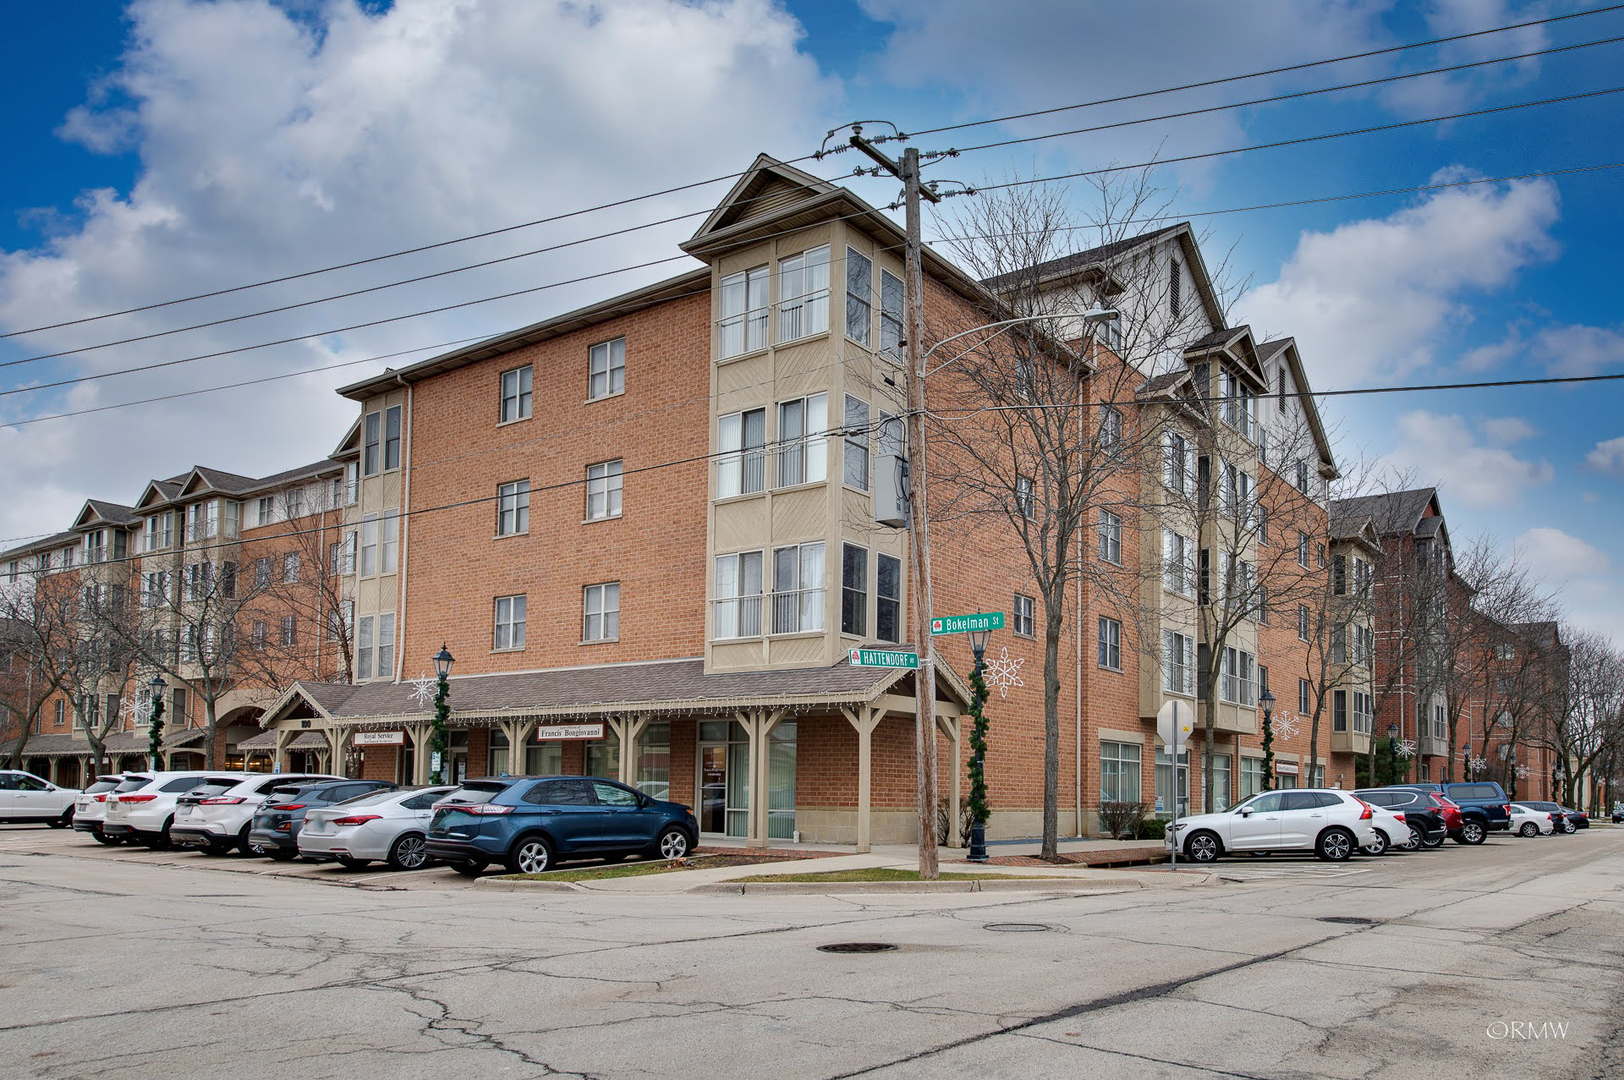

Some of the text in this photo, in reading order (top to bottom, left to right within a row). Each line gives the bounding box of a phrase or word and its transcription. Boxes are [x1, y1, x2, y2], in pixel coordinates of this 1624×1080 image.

[946, 616, 1000, 631] Bokelman St
[863, 651, 908, 666] HATTENDORF
[378, 732, 394, 740] Service
[541, 729, 562, 738] Francis
